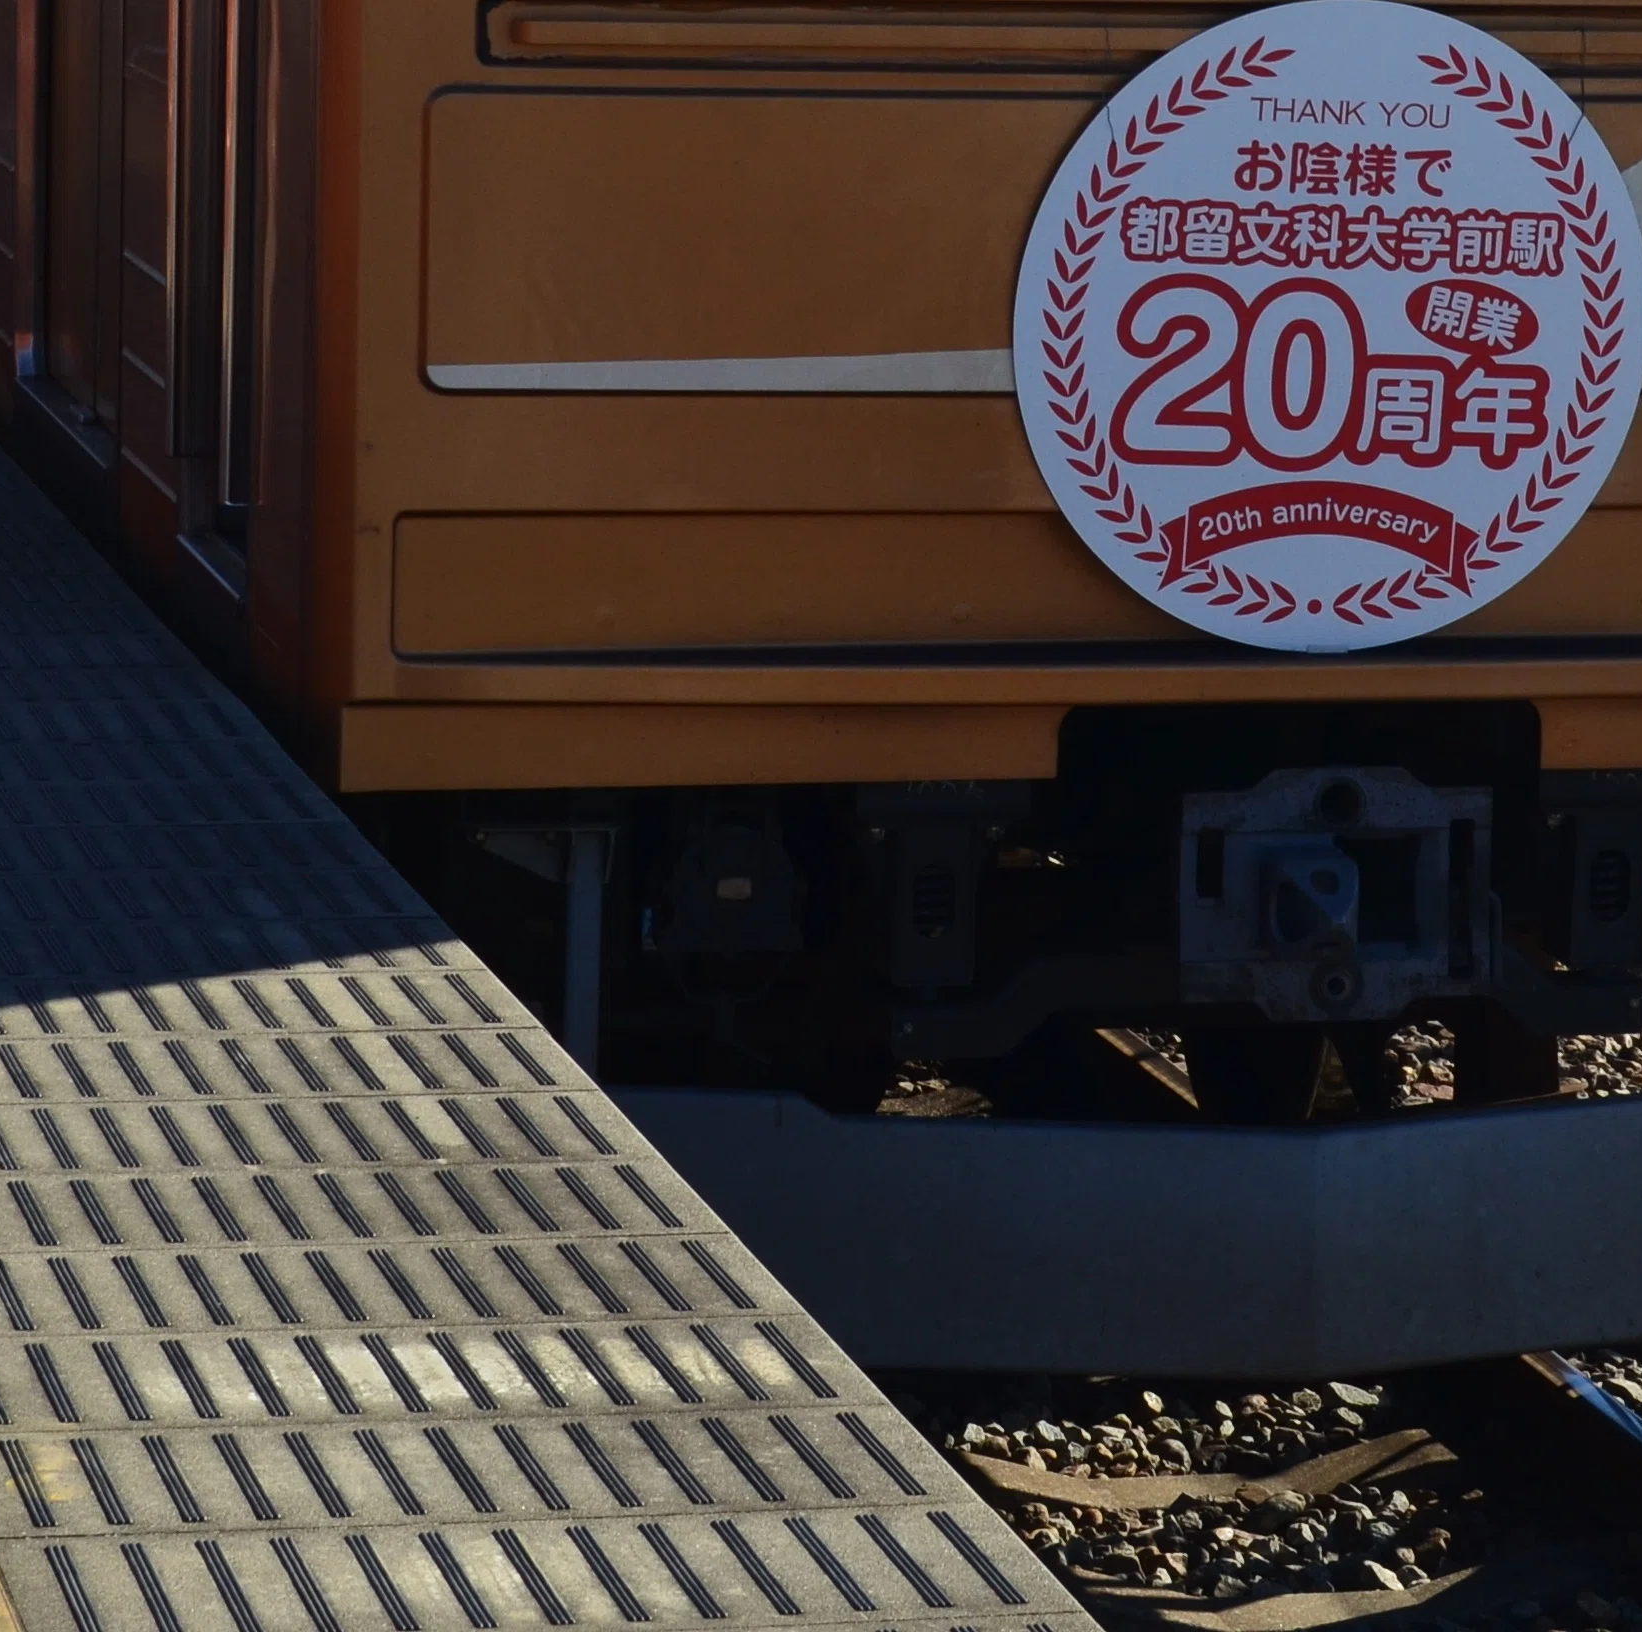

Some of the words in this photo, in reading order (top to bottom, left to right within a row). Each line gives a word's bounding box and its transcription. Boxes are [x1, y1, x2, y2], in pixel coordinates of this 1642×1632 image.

[1250, 97, 1366, 127] THANK
[1378, 102, 1451, 129] YOU
[1234, 140, 1453, 197] お陰様で
[1121, 198, 1565, 275] 都留文科大学前駅
[1421, 286, 1523, 351] 開業
[1111, 274, 1549, 470] 20周年
[1198, 507, 1262, 542] 20th
[1272, 497, 1439, 543] anniversary
